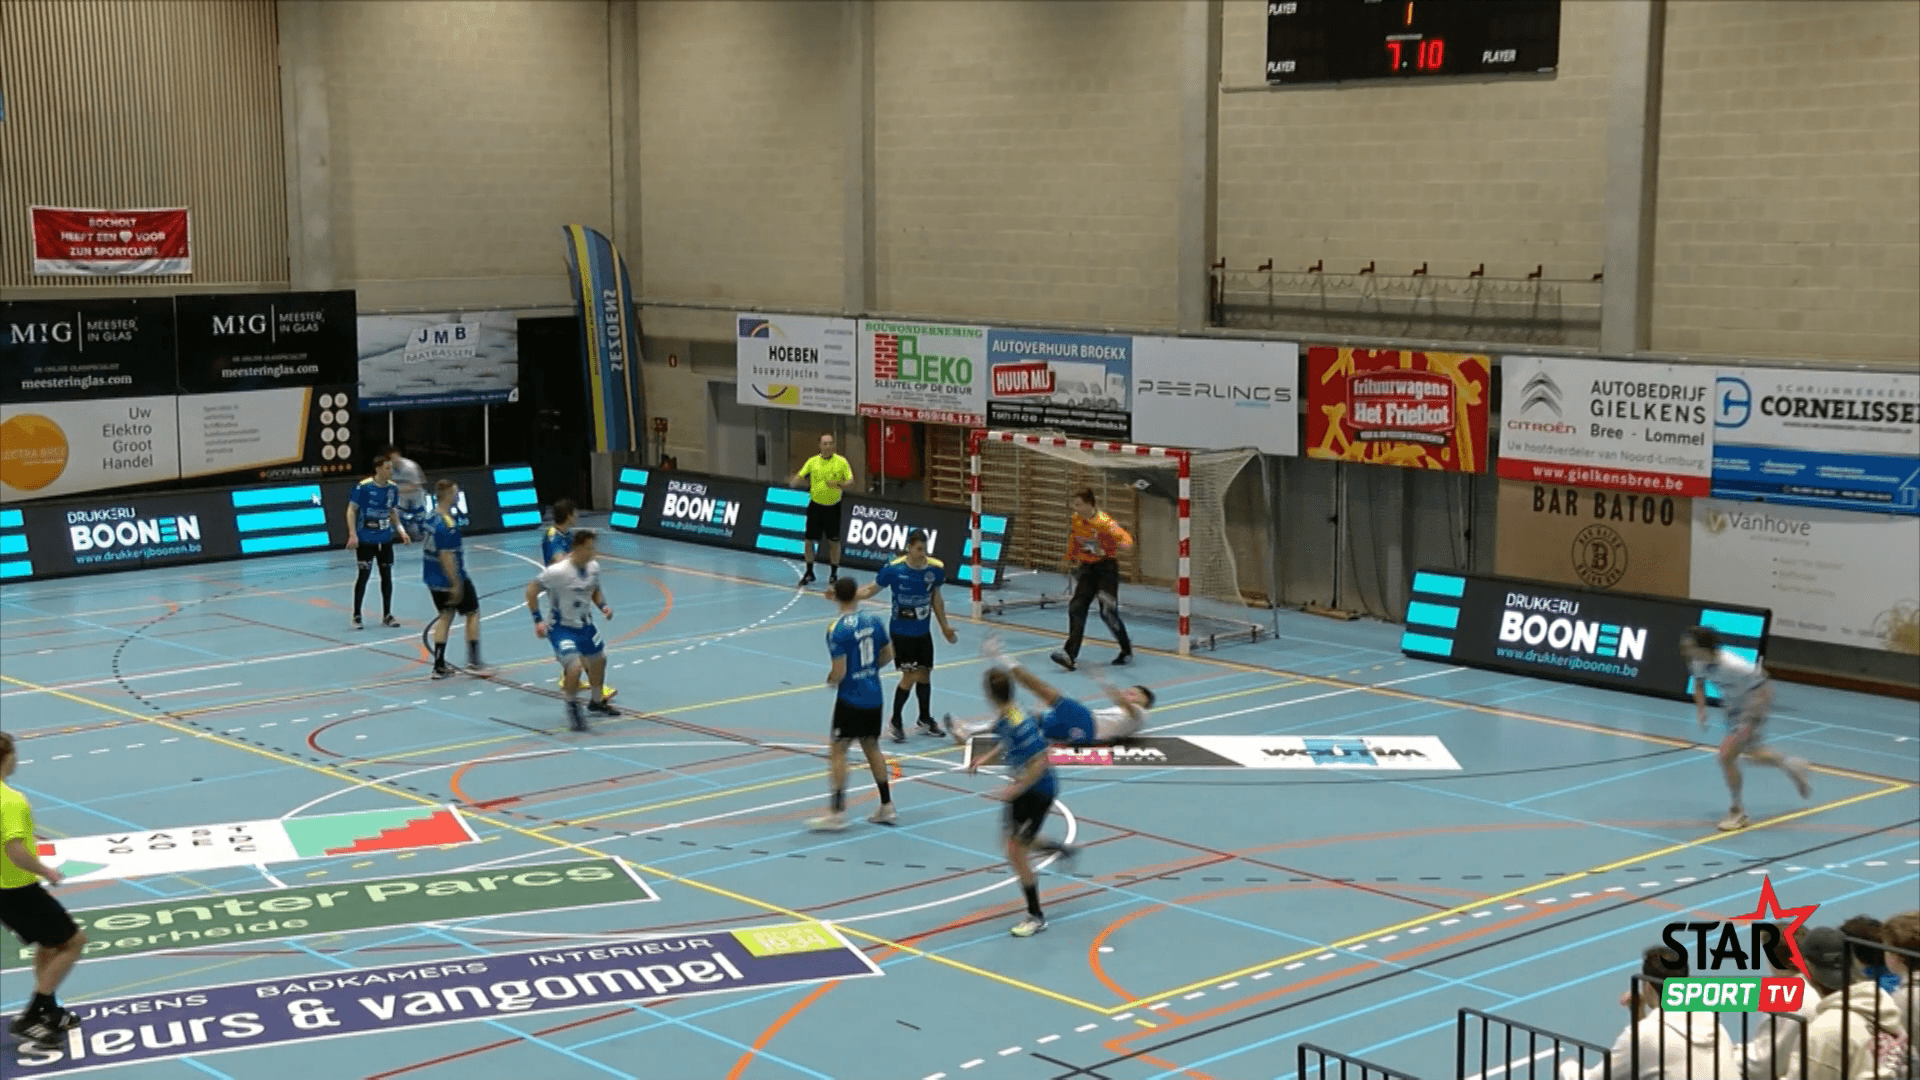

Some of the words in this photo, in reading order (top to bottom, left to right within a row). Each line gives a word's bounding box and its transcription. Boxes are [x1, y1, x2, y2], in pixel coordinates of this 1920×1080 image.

[1269, 3, 1297, 15] PLAYER
[1267, 60, 1296, 73] PLAYER
[1482, 50, 1517, 63] PLAYER
[88, 217, 137, 228] BOCHOLT
[135, 231, 165, 241] VOOR
[87, 319, 137, 330] MEESTER
[212, 313, 267, 336] MIG
[279, 311, 323, 323] MEESTER
[279, 324, 291, 333] IN
[293, 323, 319, 333] GLAS
[10, 321, 73, 344] MIG
[87, 332, 100, 342] IN
[102, 331, 133, 342] GLAS
[865, 322, 983, 338] BOUWONDERNEMING
[768, 345, 819, 363] HOEBEN
[898, 334, 972, 386] BEKO
[992, 340, 1079, 356] AUTOVERHUUR
[1080, 346, 1126, 360] BROEKX
[221, 364, 319, 378] meesteringlas.com
[752, 364, 819, 379] bouwprojecten
[996, 370, 1029, 392] HUUR
[21, 375, 133, 390] meesteringlas.com
[874, 379, 912, 390] SLEUTEL
[946, 385, 972, 395] DEUR
[1138, 379, 1292, 402] PEERLINGS
[1353, 377, 1449, 400] frituurwagens
[1590, 379, 1708, 401] AUTOBEDRIJF
[1777, 384, 1920, 398] SCHRIJNWERKERI
[129, 407, 152, 420] Uw
[1354, 402, 1382, 424] Het
[1385, 402, 1449, 426] Frietkot
[1590, 399, 1706, 424] GIELKENS
[1761, 396, 1920, 424] CORNELISSE
[102, 423, 153, 438] Elektro
[1590, 423, 1624, 440] Bree
[1645, 427, 1705, 446] Lommel
[112, 440, 153, 454] Groot
[1507, 440, 1521, 451] Uw
[1599, 451, 1618, 460] van
[102, 454, 154, 470] Handel
[1533, 465, 1684, 490] www.gielkensbree.be
[662, 493, 740, 526] BOONEN
[1533, 485, 1579, 516] BAR
[1594, 492, 1674, 526] BATOO
[70, 514, 201, 552] BOONEN
[1728, 511, 1811, 536] Vanhove
[846, 518, 938, 556] BOONN
[76, 543, 202, 565] www.drukkerijboonen.be
[1499, 610, 1648, 661] BOONEN
[1496, 646, 1640, 678] www.drukkerijboonen.be
[364, 866, 614, 902] Parcs
[19, 918, 309, 960] Eperheide
[256, 962, 489, 998] BADKAMERS
[529, 937, 715, 967] INTERIEUR
[287, 998, 341, 1029] &
[358, 952, 745, 1020] vangompel
